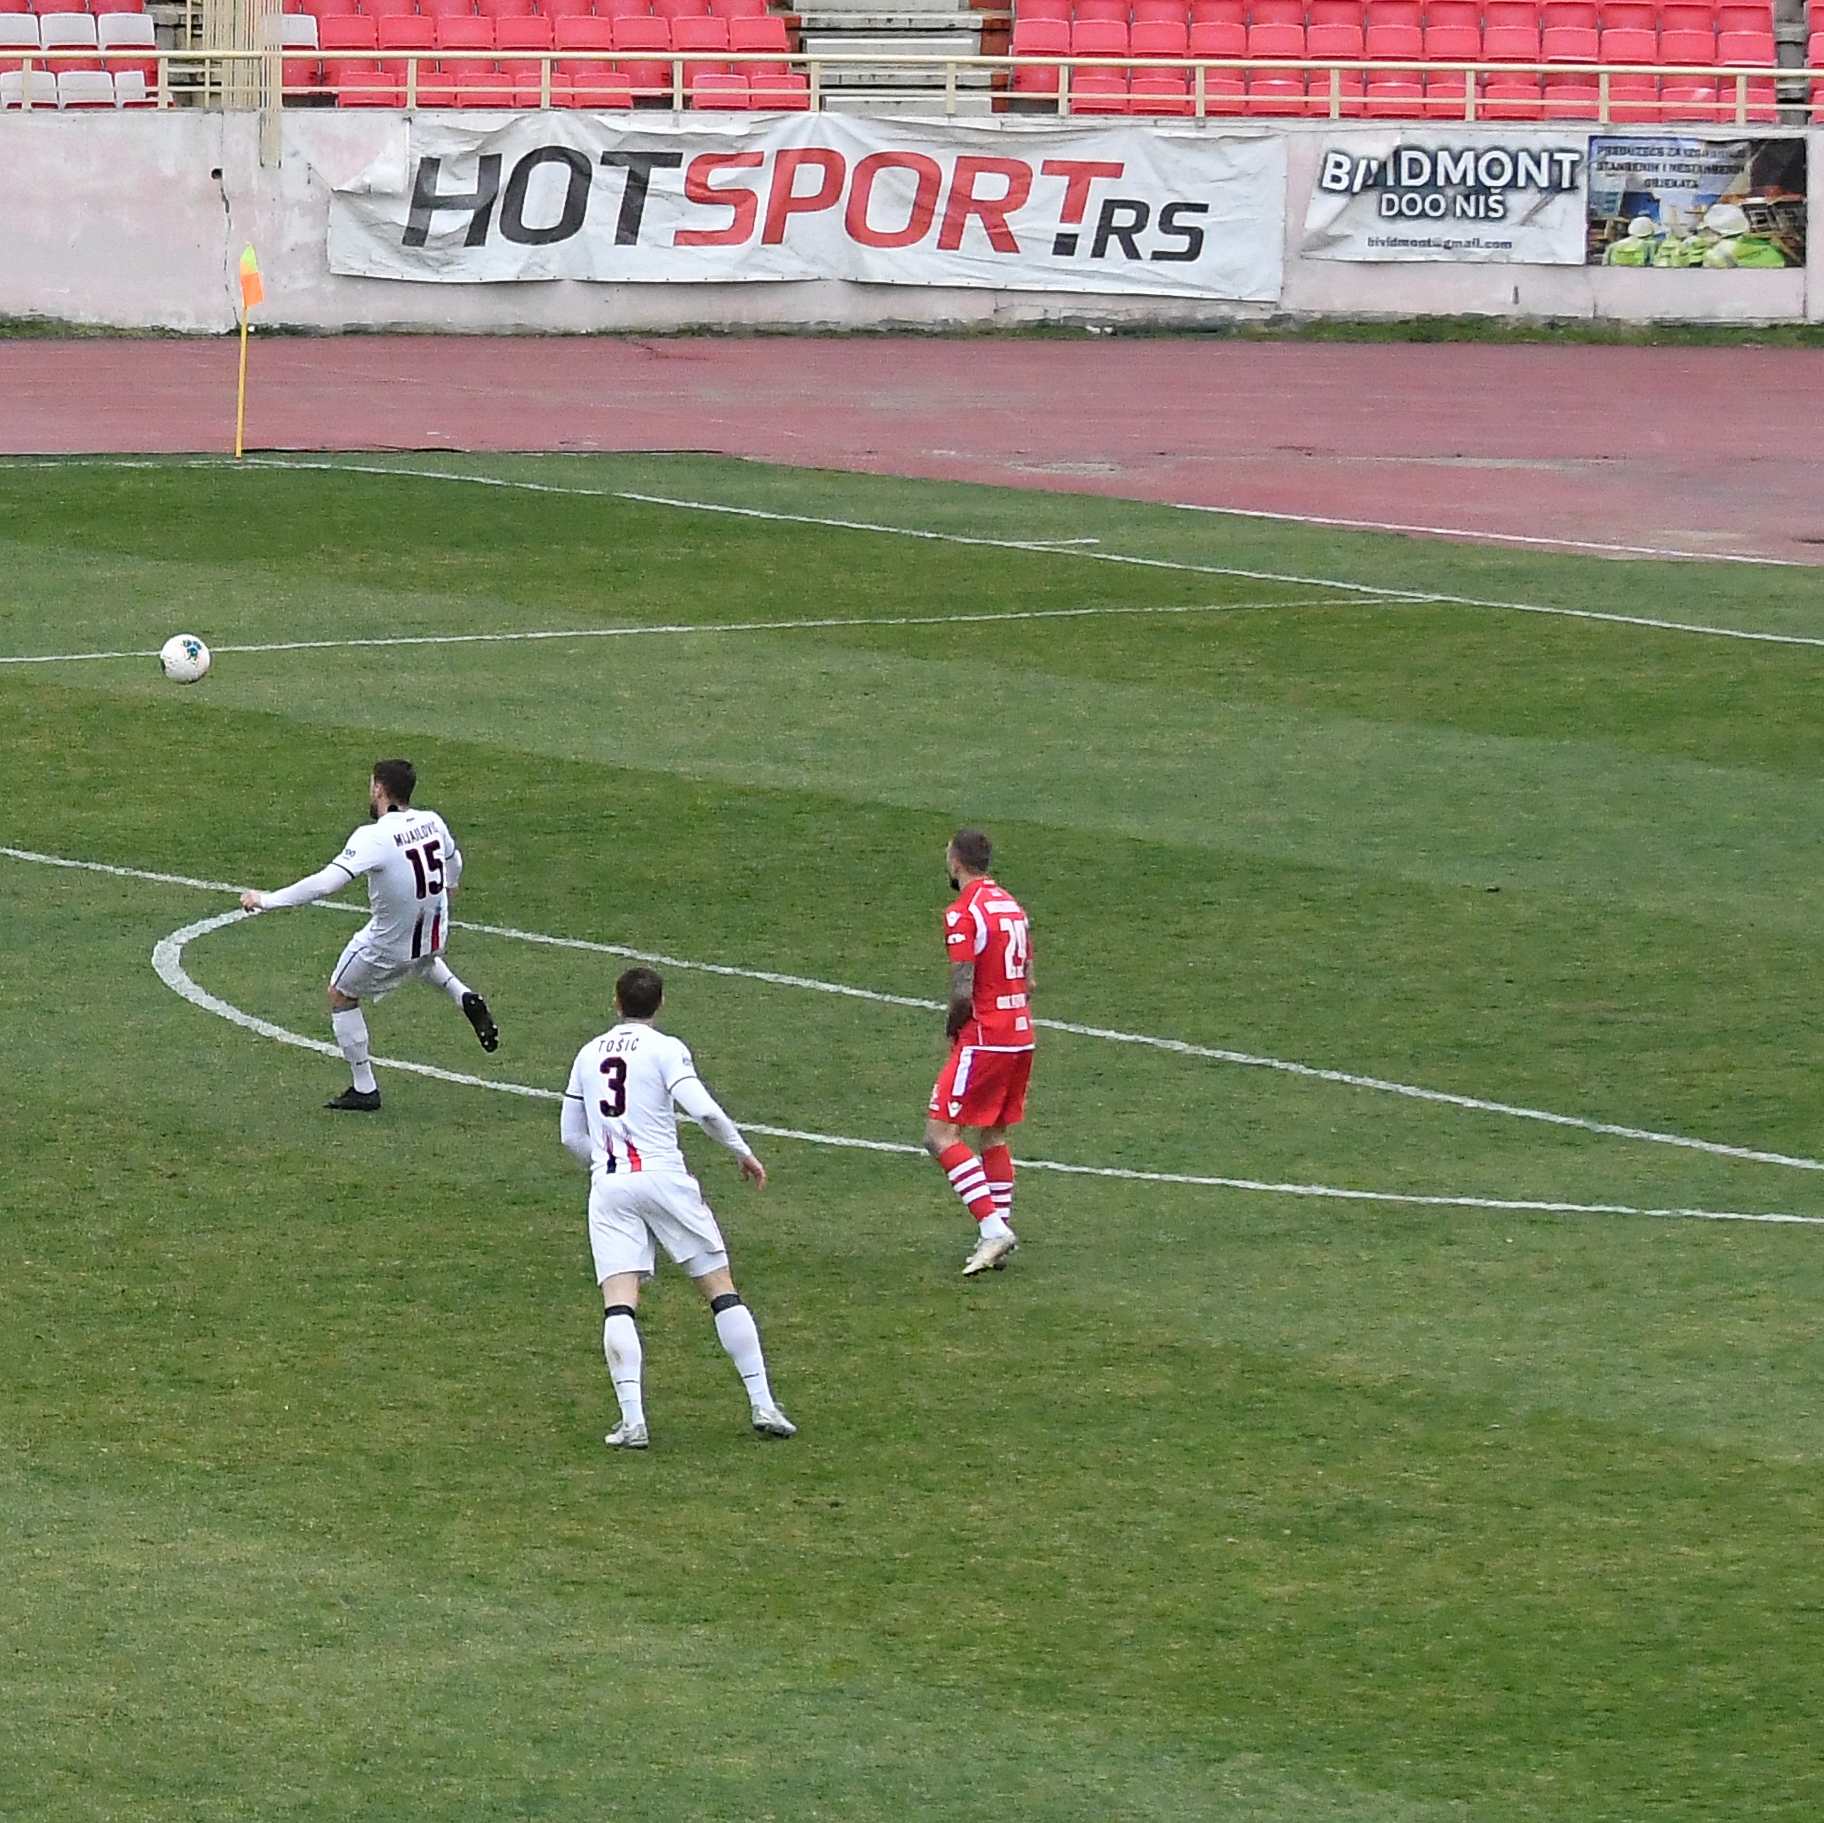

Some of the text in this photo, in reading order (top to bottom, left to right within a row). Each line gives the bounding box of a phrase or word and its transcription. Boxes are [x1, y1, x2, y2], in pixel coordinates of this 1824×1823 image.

[1379, 188, 1505, 219] DOO NIŠ
[404, 839, 445, 900] 15
[599, 1056, 628, 1118] 3
